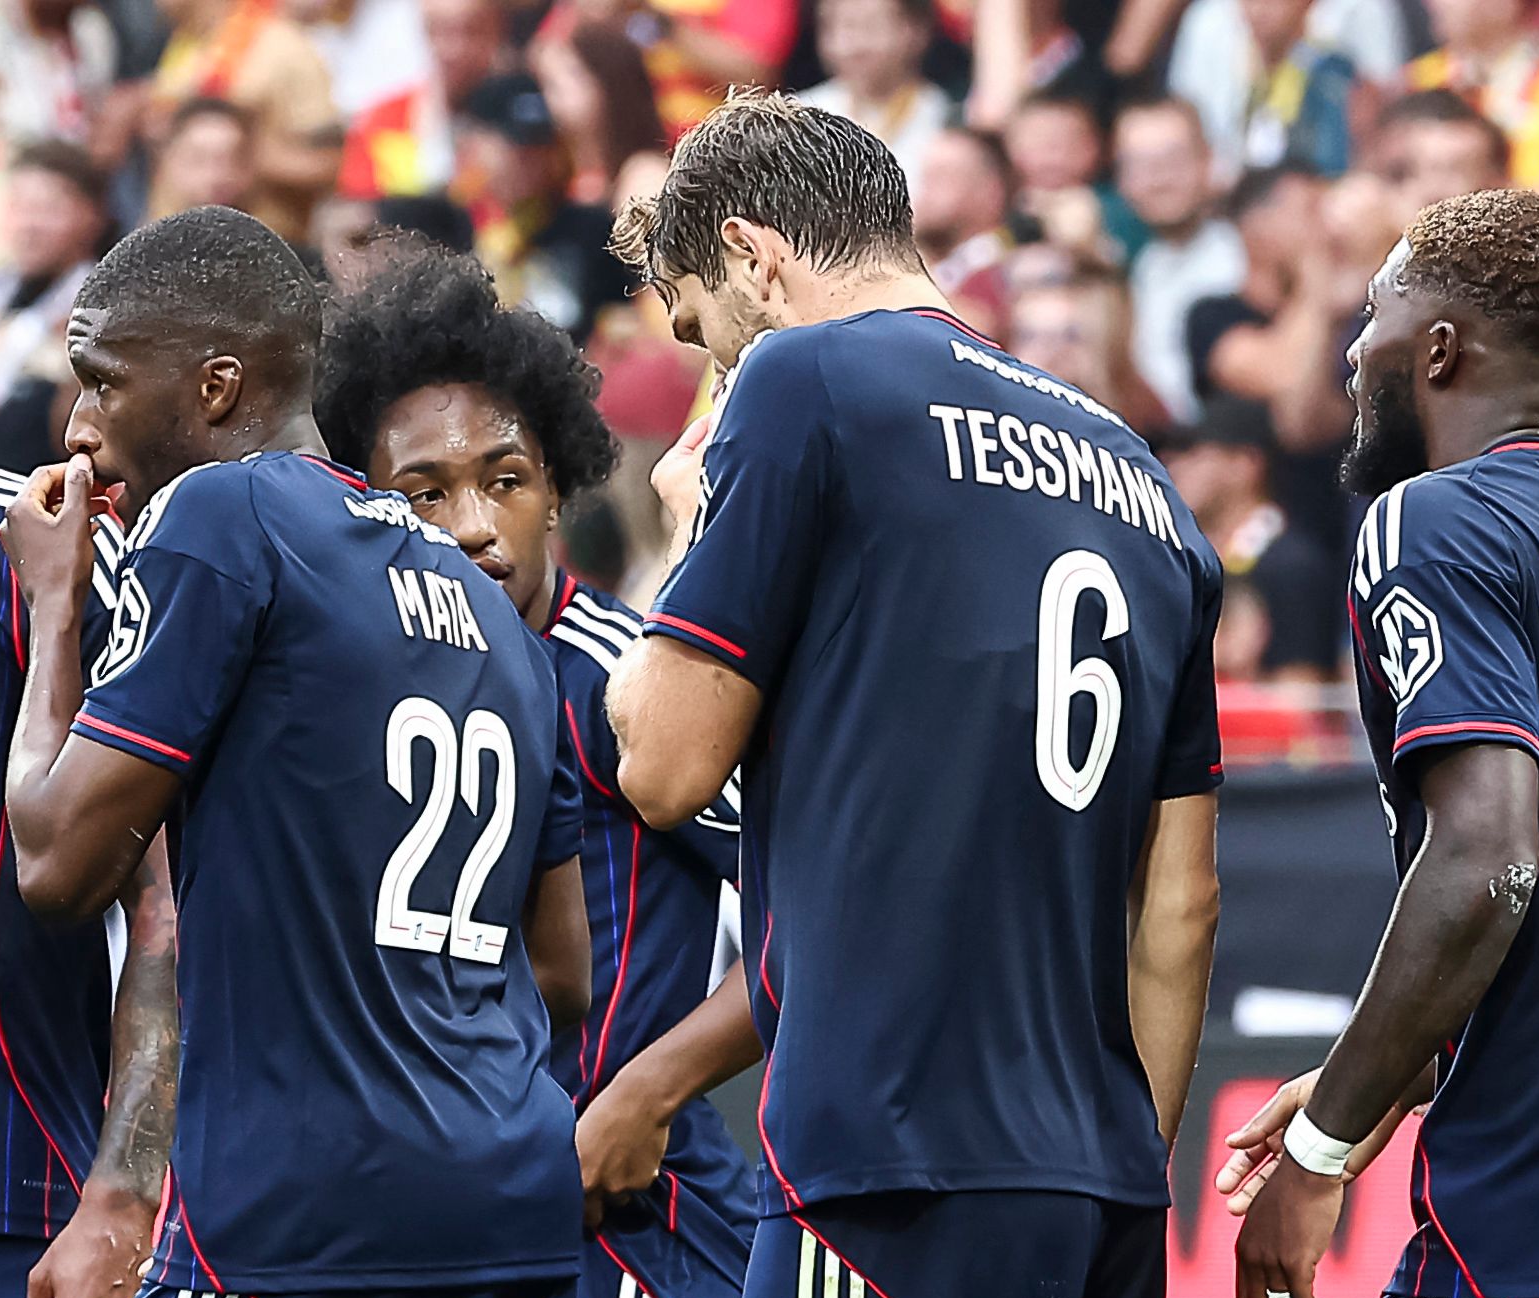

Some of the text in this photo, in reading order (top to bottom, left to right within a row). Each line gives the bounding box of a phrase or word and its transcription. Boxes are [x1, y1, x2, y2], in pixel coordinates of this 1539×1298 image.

[929, 404, 1183, 551] TESSMANN
[387, 566, 489, 652] MATA
[1035, 549, 1130, 811] 6
[375, 697, 517, 965] 22
